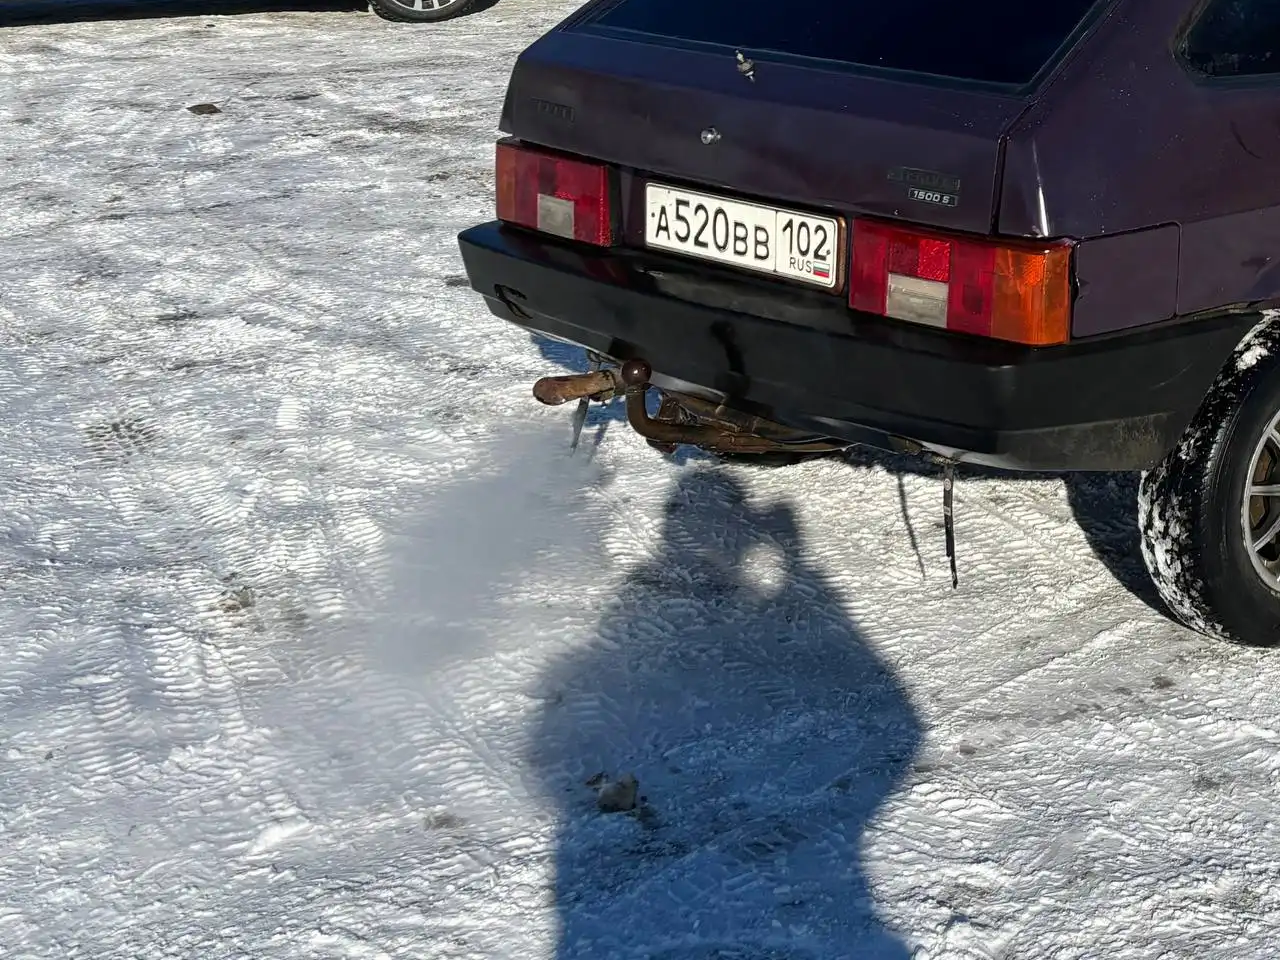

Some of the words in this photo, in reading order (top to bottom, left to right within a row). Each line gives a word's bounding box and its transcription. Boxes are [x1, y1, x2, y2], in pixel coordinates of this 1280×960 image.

[913, 190, 941, 202] 1500
[655, 199, 770, 261] А520ВВ
[782, 218, 828, 262] 102
[789, 256, 812, 273] RUS
